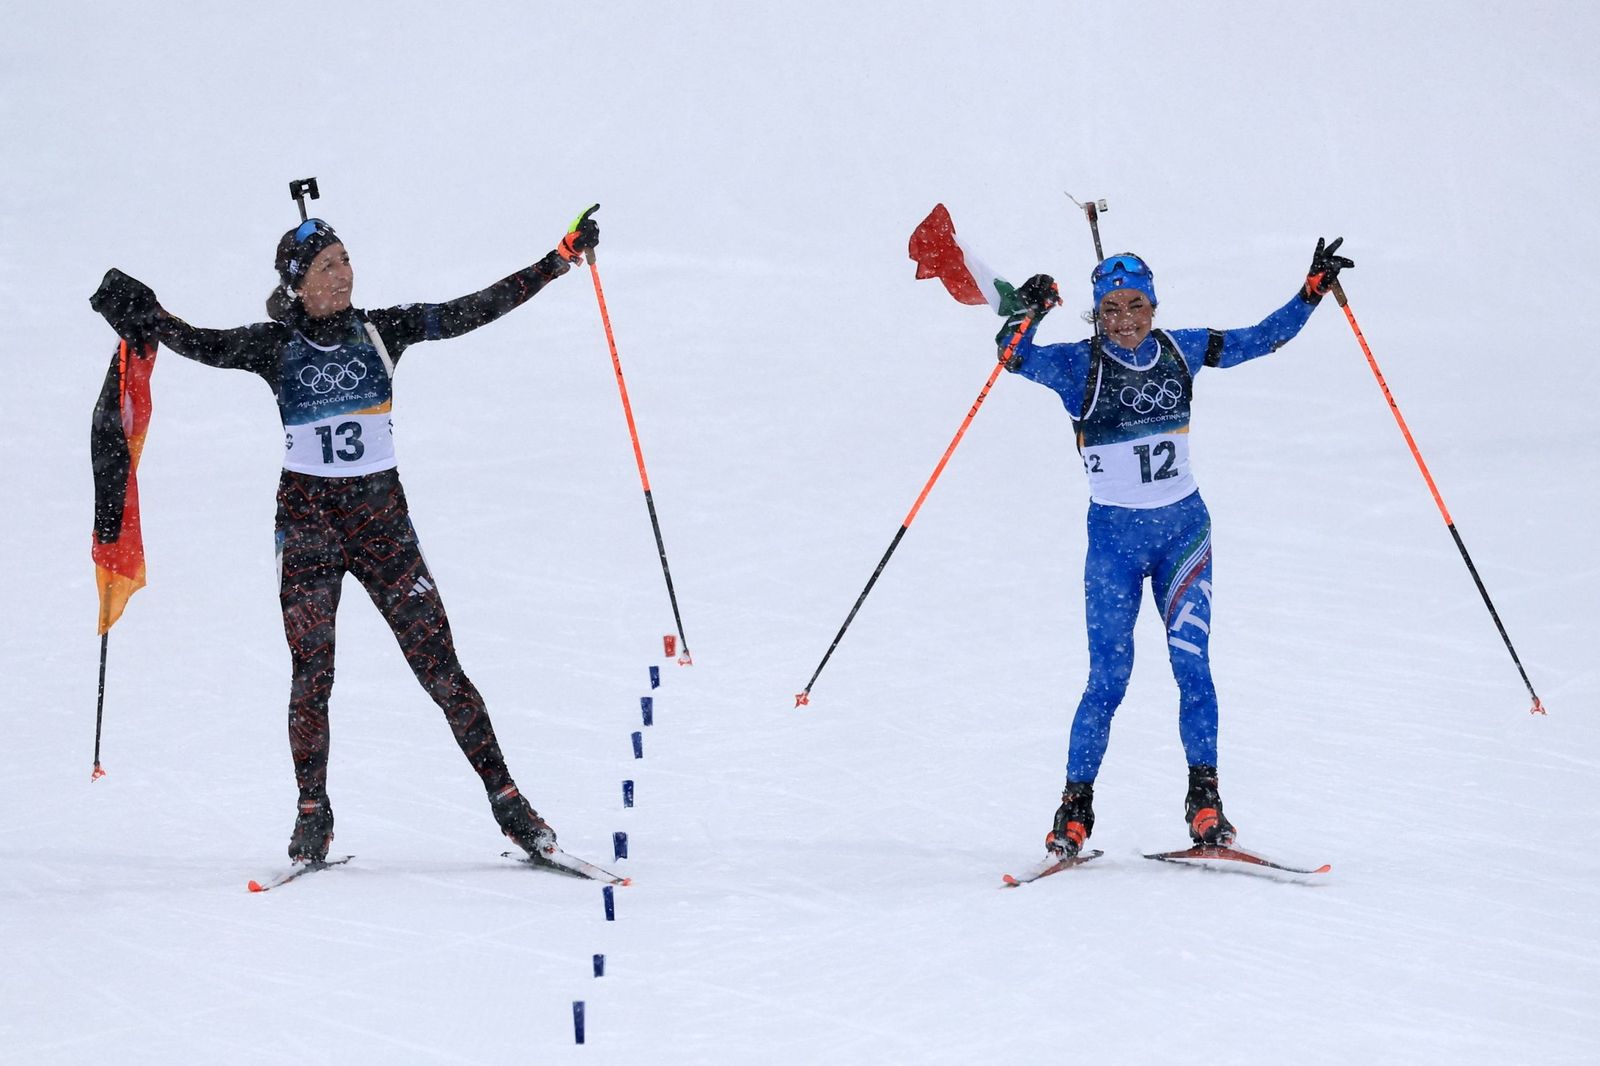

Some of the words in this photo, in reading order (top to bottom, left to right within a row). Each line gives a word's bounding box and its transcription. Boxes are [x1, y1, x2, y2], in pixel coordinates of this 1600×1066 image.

[297, 398, 329, 408] MILANO
[329, 394, 363, 404] CORTINA
[1116, 417, 1150, 428] MILANO
[1150, 413, 1181, 424] CORTINA
[314, 421, 365, 464] 13
[1133, 440, 1178, 484] 12
